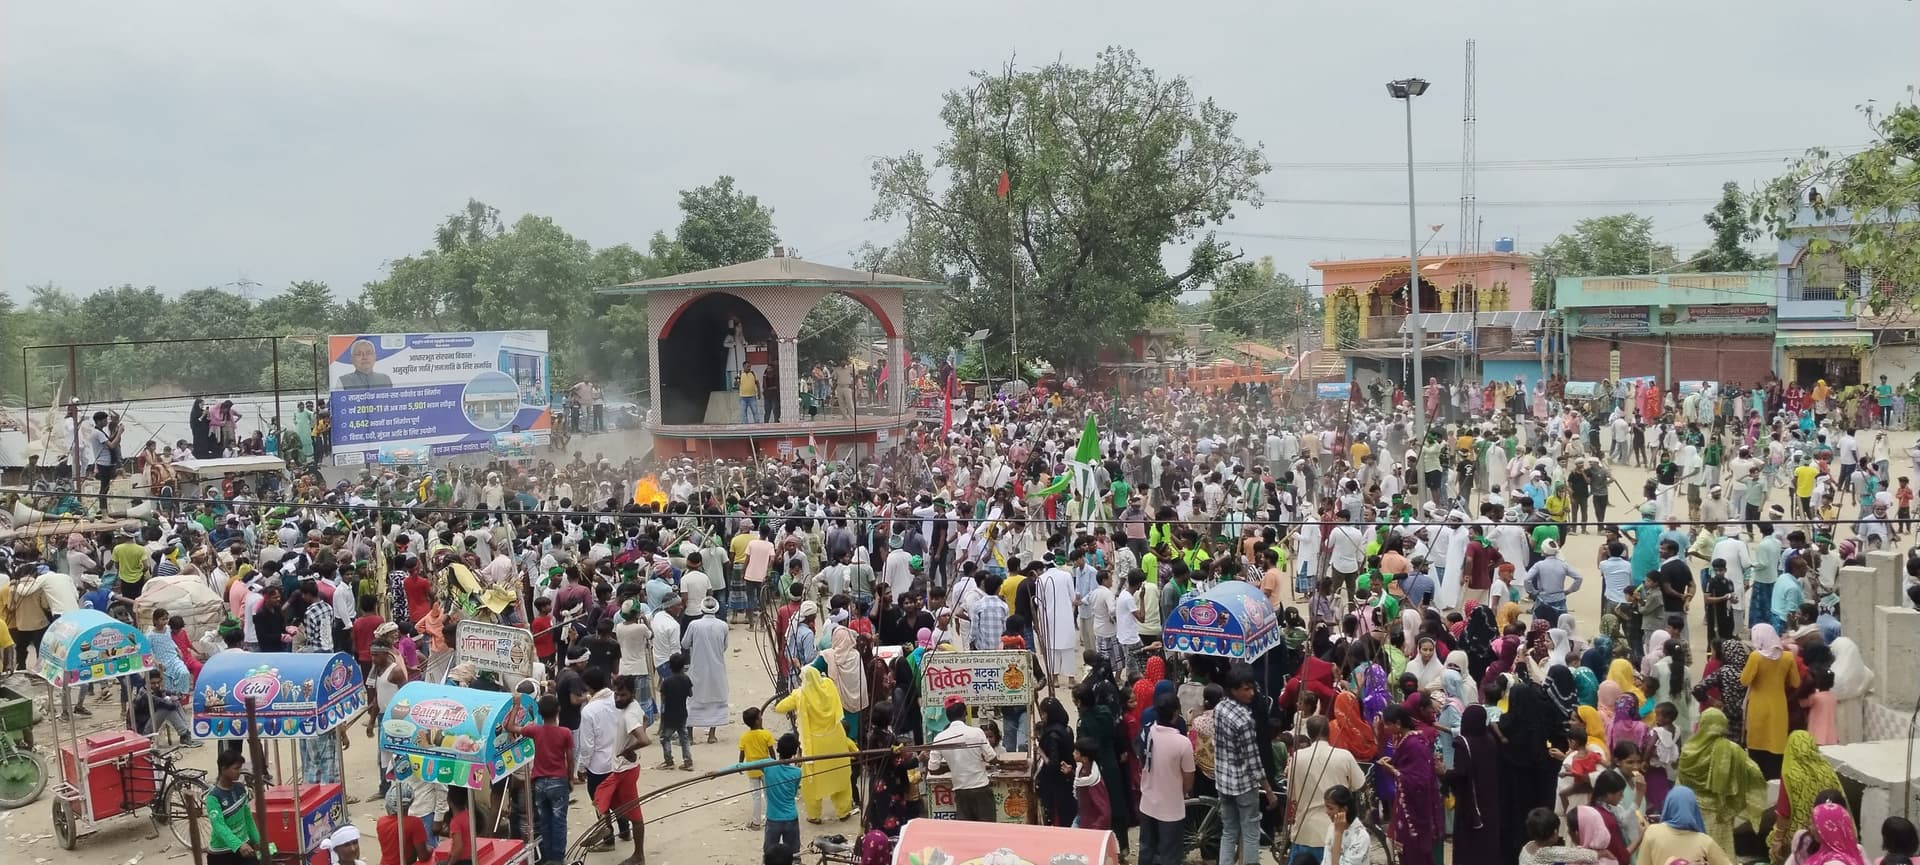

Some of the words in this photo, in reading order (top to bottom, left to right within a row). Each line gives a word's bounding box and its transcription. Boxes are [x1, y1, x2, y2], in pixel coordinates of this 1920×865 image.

[455, 350, 473, 360] विकास
[392, 364, 418, 375] अनुसूचित
[456, 362, 462, 371] के
[462, 361, 473, 371] लिए
[416, 389, 424, 397] का
[424, 388, 441, 396] निर्माण
[356, 405, 383, 414] 2010-11
[383, 404, 390, 412] से
[398, 403, 407, 411] तक
[407, 401, 427, 411] 5,901
[348, 419, 370, 430] 4,642
[385, 418, 393, 426] का
[393, 416, 411, 425] निर्माण
[391, 429, 403, 437] आदि
[403, 428, 409, 436] के
[409, 427, 419, 436] लिए
[926, 666, 972, 691] विवेक
[974, 667, 1001, 678] मटका
[971, 678, 999, 693] कुल्फी
[411, 705, 442, 721] Dairy
[441, 708, 467, 722] Milk
[429, 719, 453, 728] CREAM
